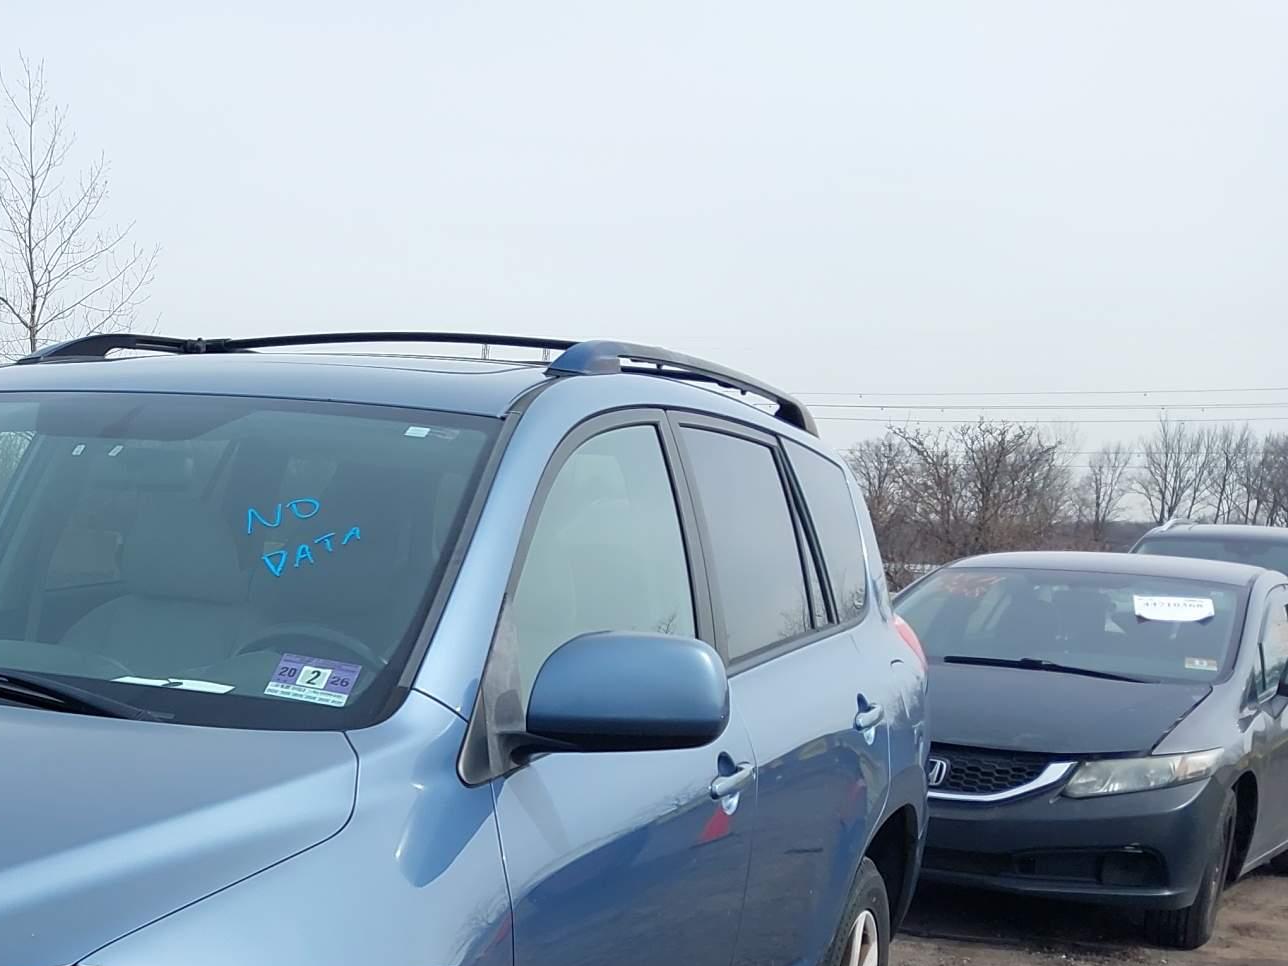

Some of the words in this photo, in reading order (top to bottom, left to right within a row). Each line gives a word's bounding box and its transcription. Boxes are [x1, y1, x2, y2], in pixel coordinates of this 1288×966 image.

[247, 498, 320, 534] NO
[261, 526, 362, 577] DATA
[278, 665, 298, 679] 20
[306, 670, 322, 686] 2
[330, 675, 350, 688] 26
